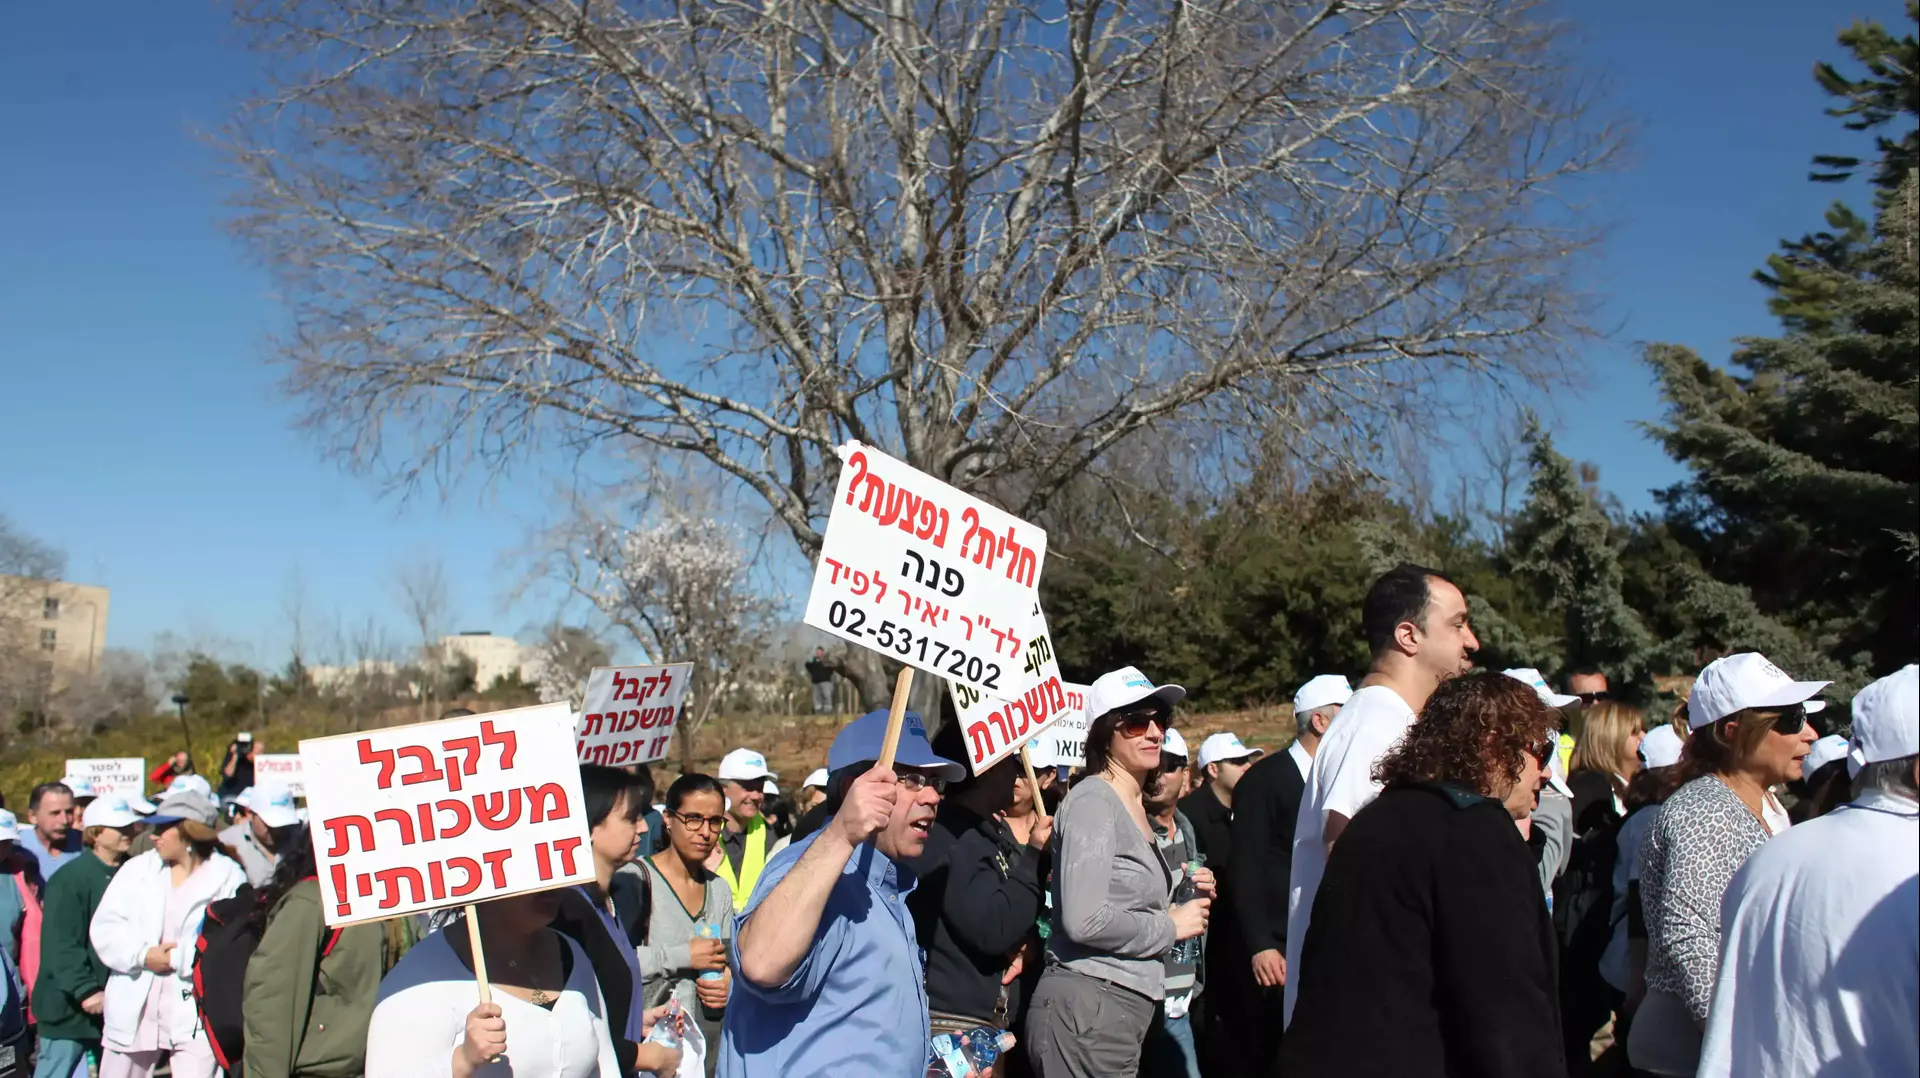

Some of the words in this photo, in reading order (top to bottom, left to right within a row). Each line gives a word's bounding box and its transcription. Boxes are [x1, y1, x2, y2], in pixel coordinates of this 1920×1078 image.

[845, 451, 949, 549] נפצעת?
[960, 507, 1037, 589] חלית?
[825, 556, 888, 605] לפיד
[901, 549, 965, 597] פנה
[897, 589, 949, 628] יאיר
[828, 600, 1001, 690] 02-5317202
[960, 615, 1021, 659] לד"ר
[1024, 634, 1052, 678] מקב
[612, 668, 672, 706] לקבל
[580, 705, 675, 737] משכורת
[967, 676, 1066, 763] משכורת
[357, 720, 517, 792] לקבל
[648, 736, 669, 759] זו
[323, 782, 570, 857] משכורת
[330, 848, 512, 917] זכותי!
[534, 836, 582, 881] זו
